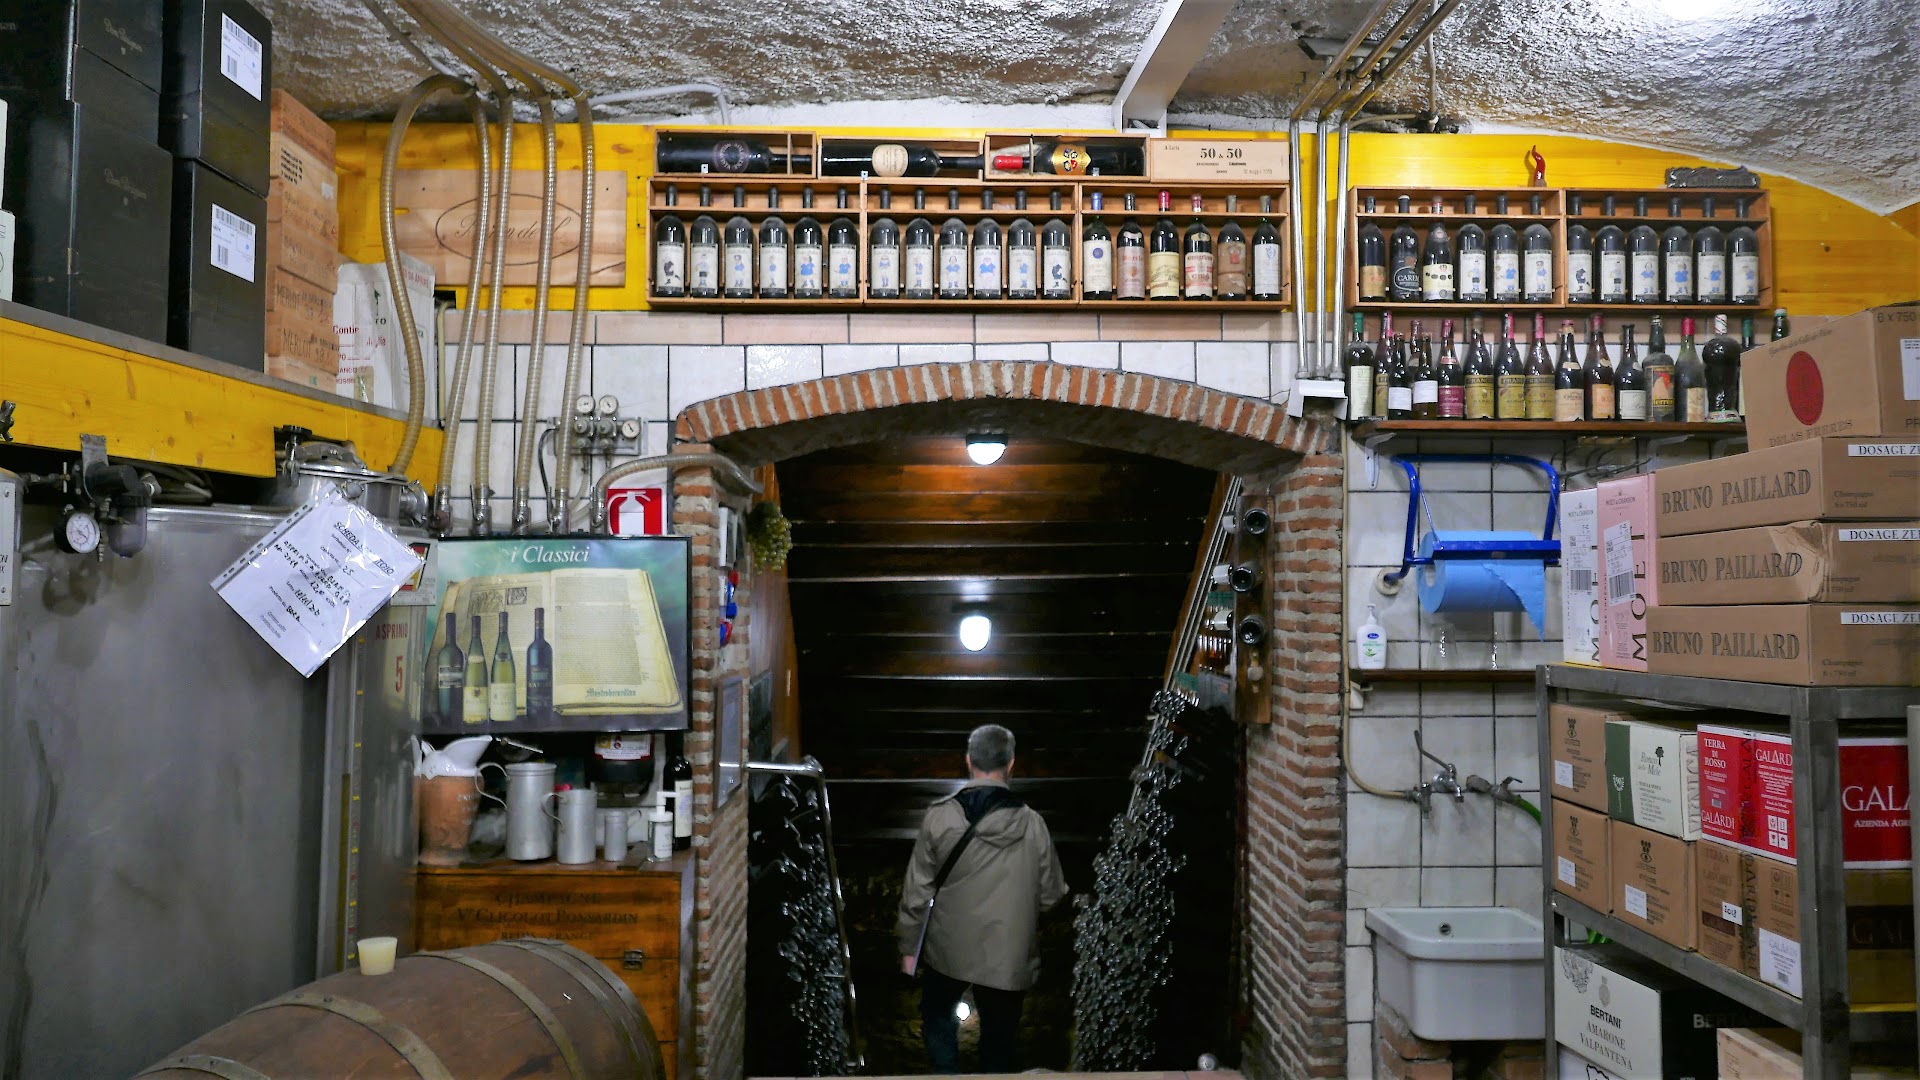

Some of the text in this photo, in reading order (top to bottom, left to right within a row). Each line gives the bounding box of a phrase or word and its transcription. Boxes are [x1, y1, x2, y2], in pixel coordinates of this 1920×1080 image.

[1200, 148, 1216, 159] 50
[1226, 148, 1243, 159] 50
[1859, 445, 1906, 456] DOSAGE
[1662, 468, 1811, 515] BRUNO PAILLARD
[1850, 530, 1900, 540] DOSAGE
[523, 545, 590, 563] Classici
[1661, 551, 1803, 584] BRUNO PAILLARD
[1851, 613, 1900, 624] DOSAGE
[1652, 631, 1800, 660] BRUNO PAILLARD
[395, 655, 404, 693] 5
[1704, 738, 1726, 750] TERRA
[1704, 757, 1726, 769] ROSSO
[1711, 750, 1719, 758] DI
[1755, 748, 1793, 766] GALARD
[1701, 810, 1735, 830] GALARDI
[1854, 819, 1889, 828] AZIENDA
[1590, 1004, 1622, 1030] BERTANI
[1586, 1020, 1626, 1051] AMARONE
[1579, 1032, 1633, 1071] VALPANTENA
